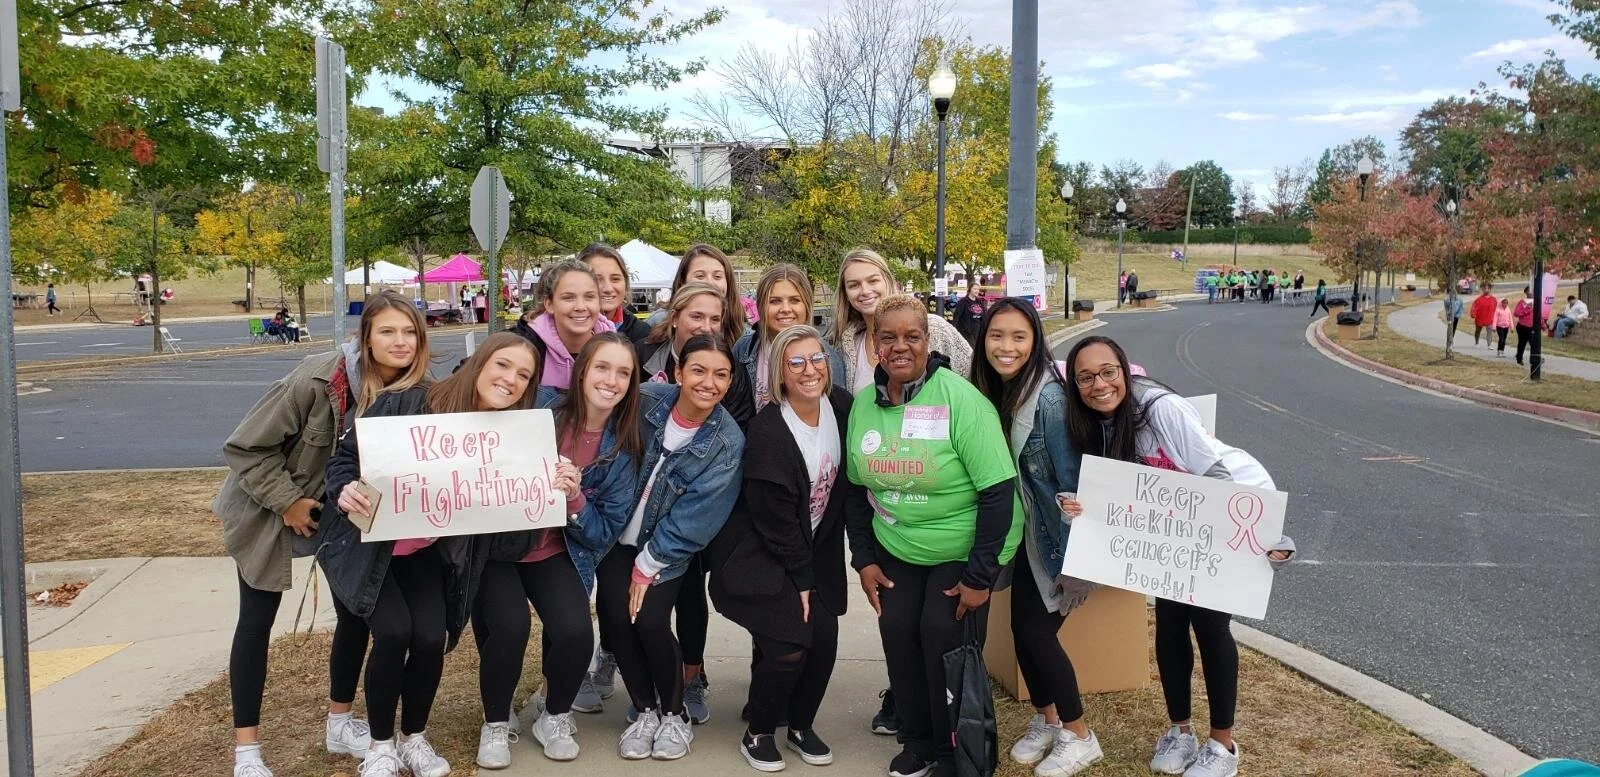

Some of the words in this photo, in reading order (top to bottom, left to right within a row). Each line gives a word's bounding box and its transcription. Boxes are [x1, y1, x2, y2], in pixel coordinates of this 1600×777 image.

[410, 425, 500, 465] Keep
[867, 459, 924, 475] YOUNITED
[393, 456, 556, 528] Fighting!
[1136, 472, 1205, 520] Keep
[1124, 562, 1195, 603] booty!
